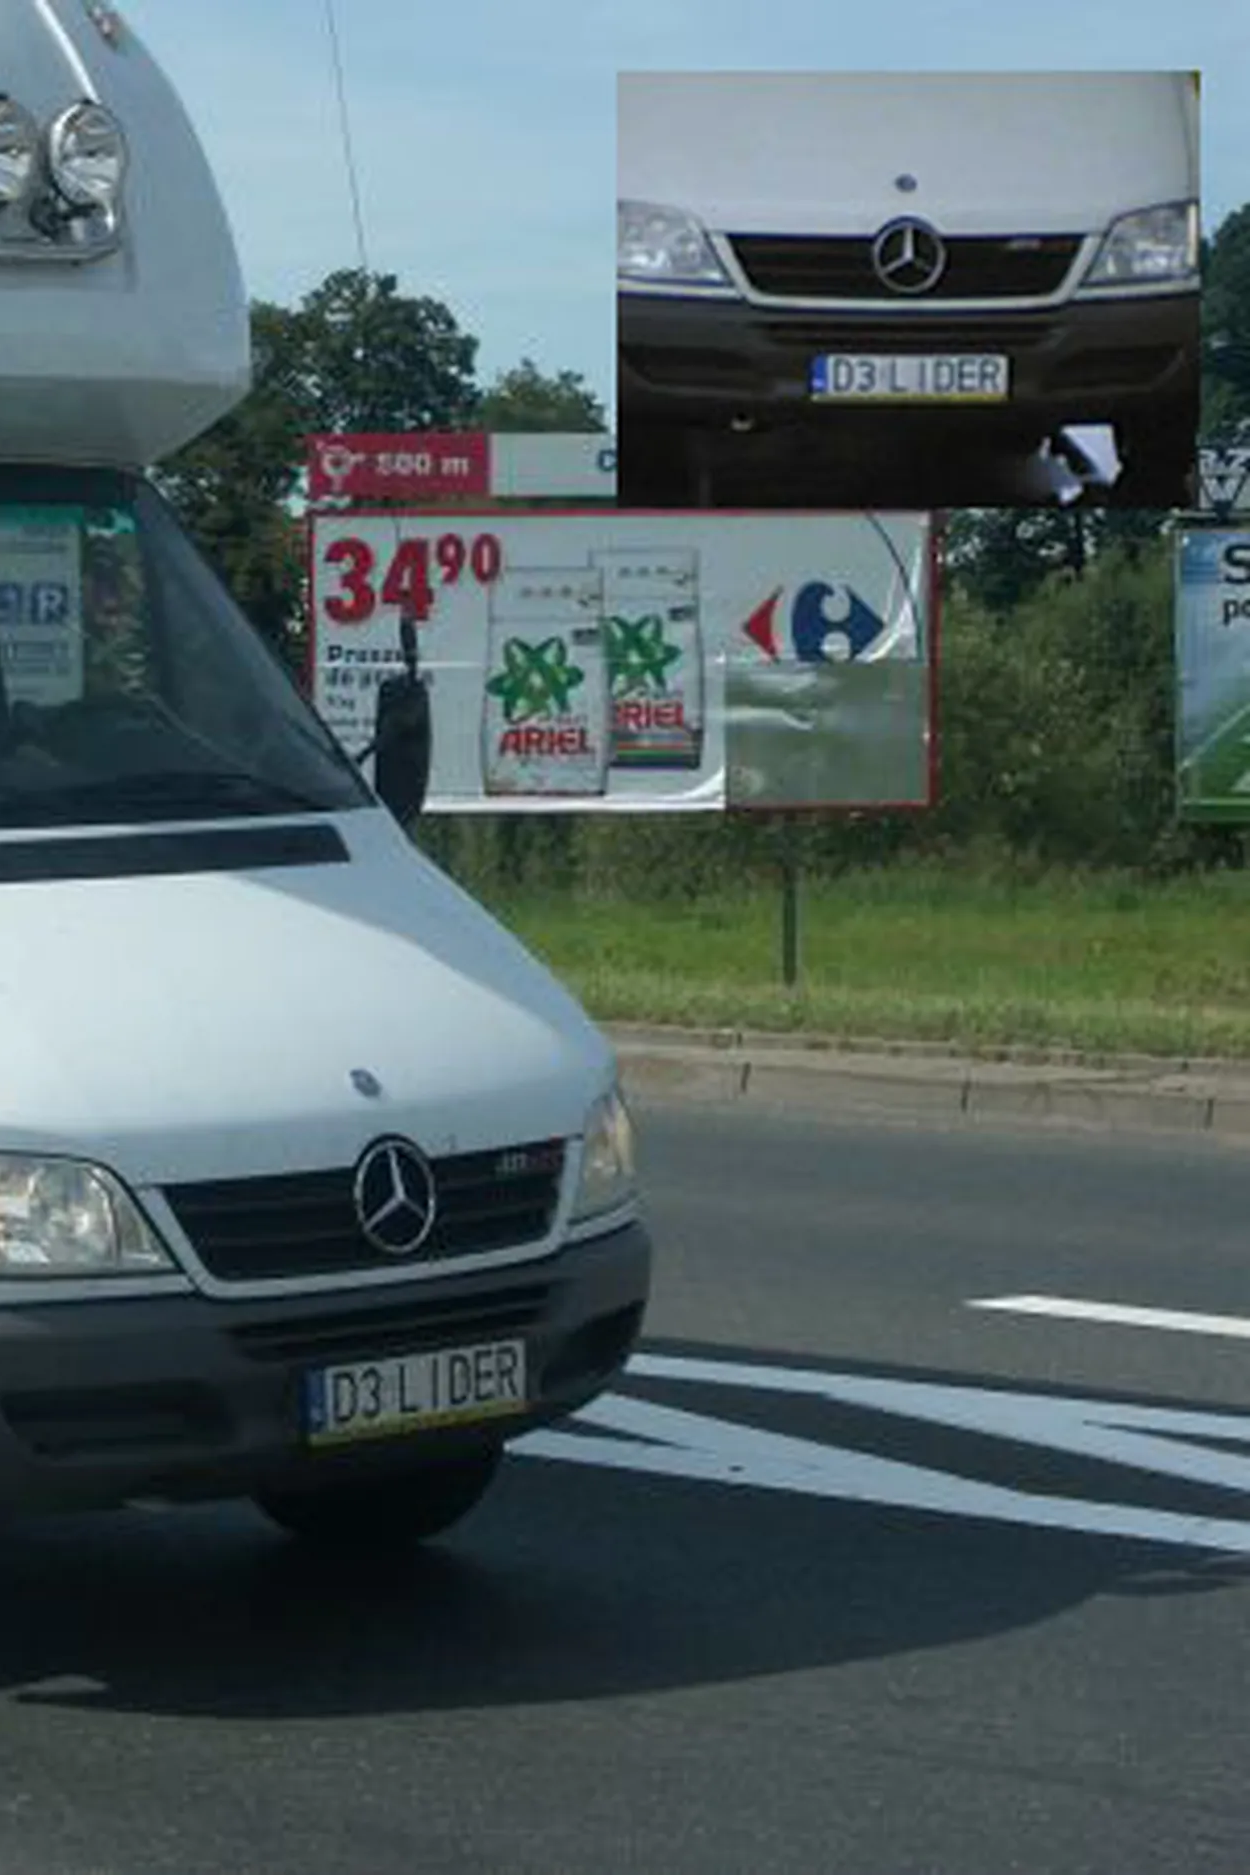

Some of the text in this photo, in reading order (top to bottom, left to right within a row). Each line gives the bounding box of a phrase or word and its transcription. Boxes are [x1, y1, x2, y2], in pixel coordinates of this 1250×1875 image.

[832, 357, 1000, 392] D3 LIDER
[499, 726, 593, 757] ARIEL
[332, 1345, 519, 1423] D3 LIDER
